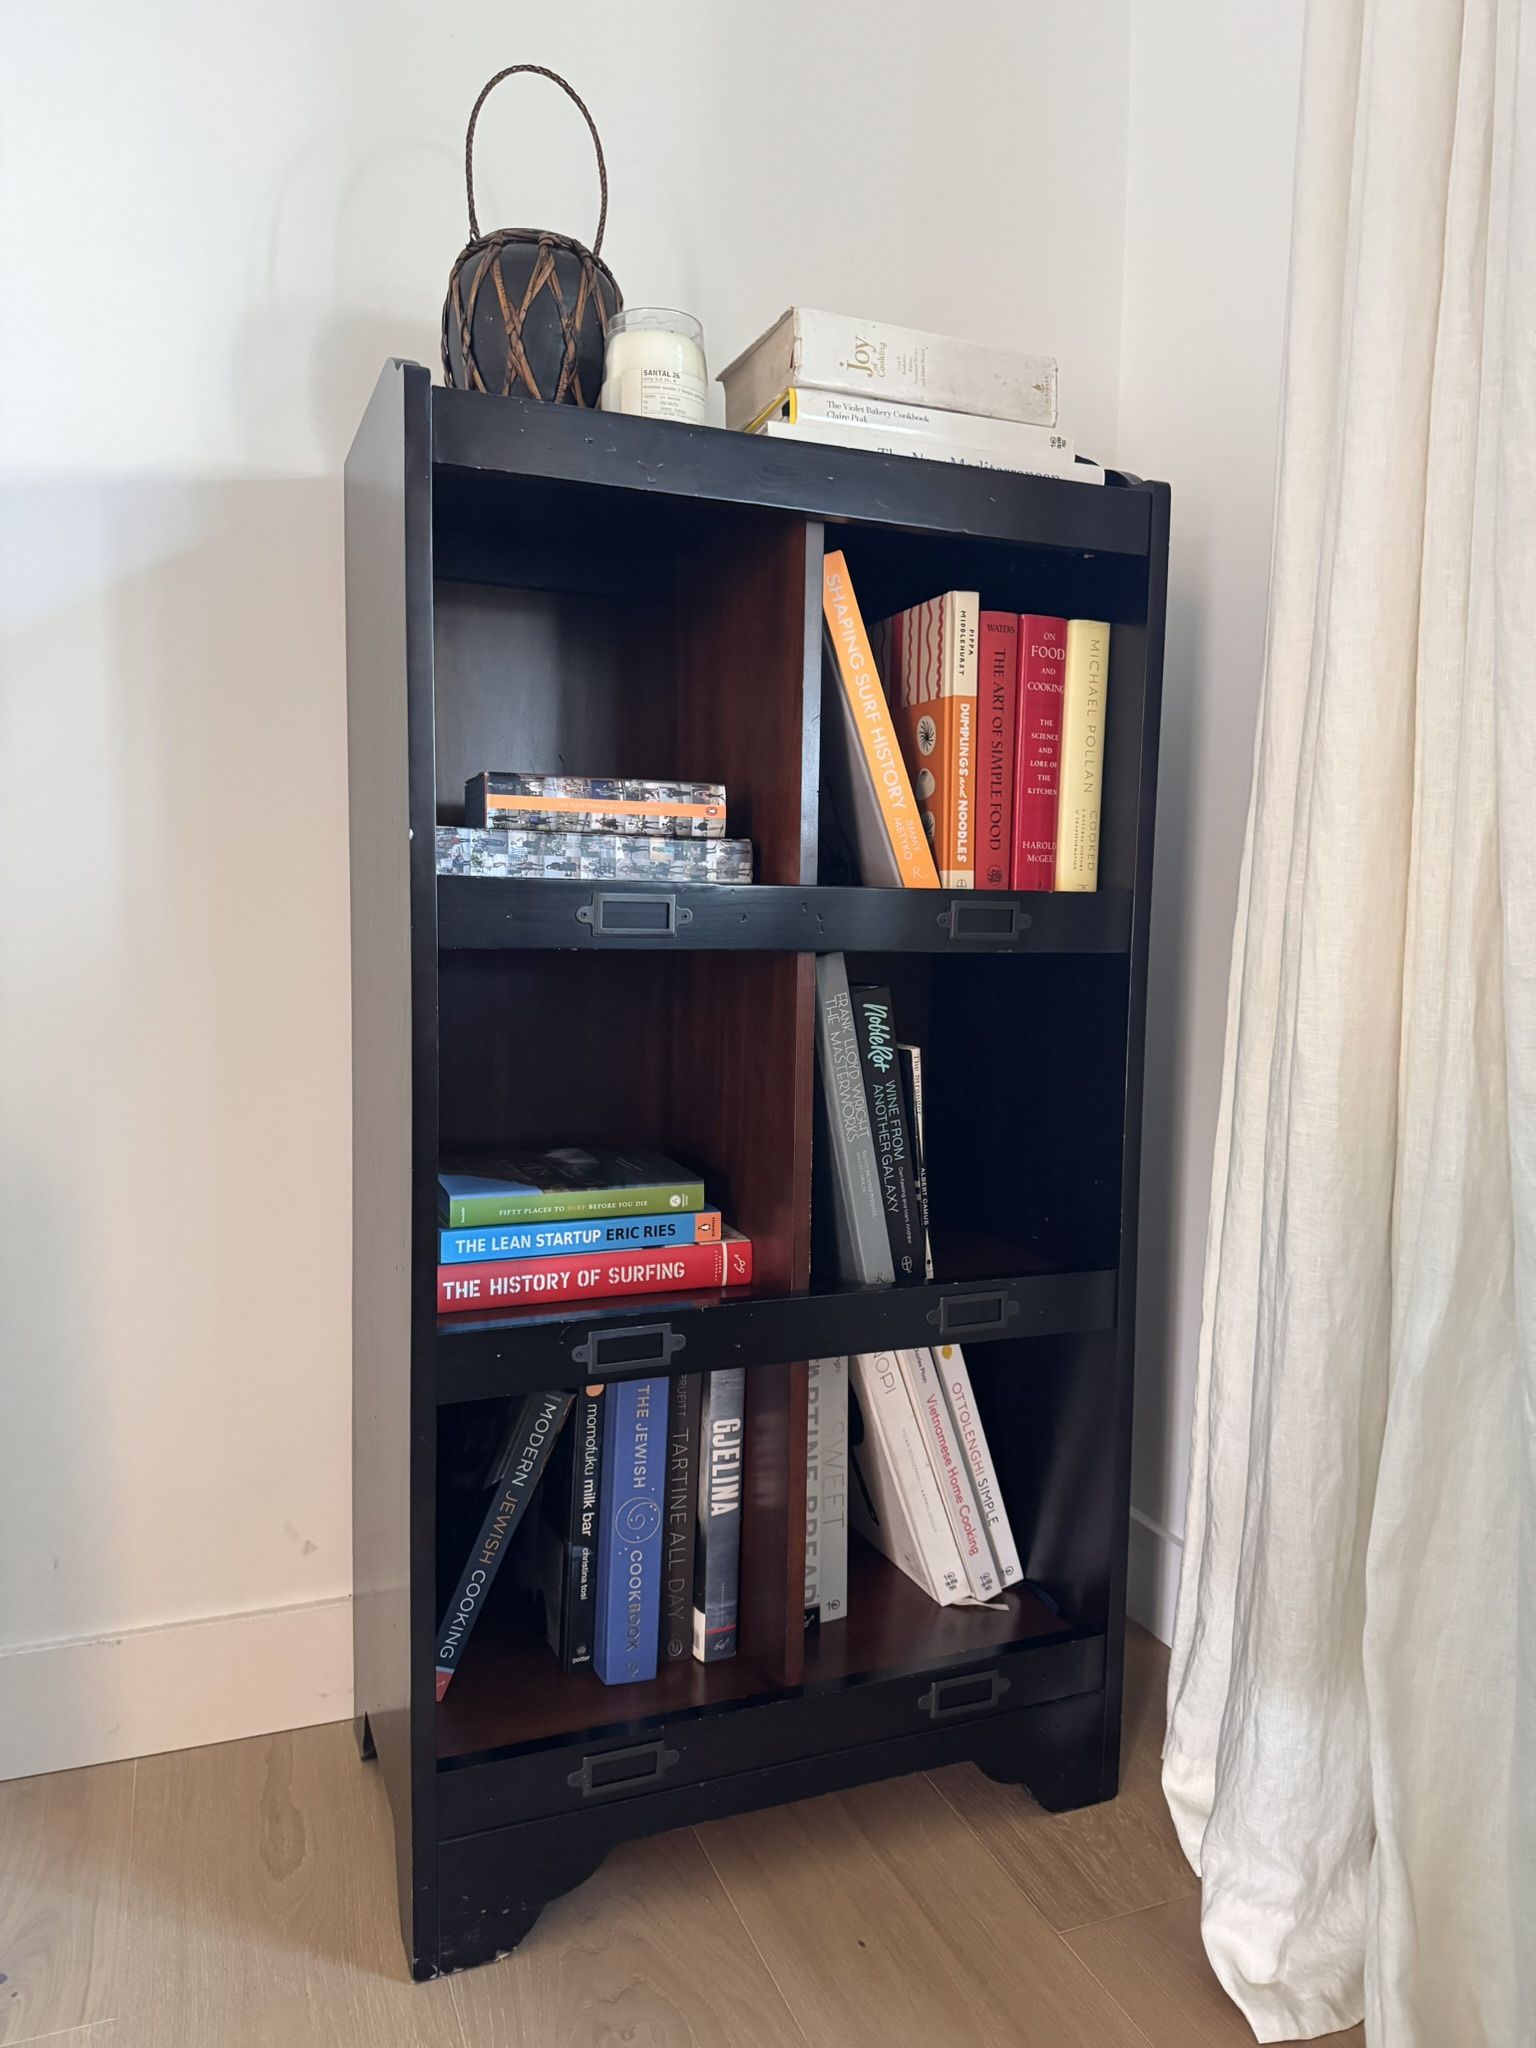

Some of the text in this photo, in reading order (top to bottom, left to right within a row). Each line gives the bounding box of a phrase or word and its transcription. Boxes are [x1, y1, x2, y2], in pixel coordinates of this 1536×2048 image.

[644, 370, 671, 378] SANTAL
[878, 341, 888, 378] Cooking
[826, 400, 930, 423] The Violet Bakery Cookbook
[826, 411, 850, 421] Claire
[958, 610, 966, 676] MIDDLEHURST
[987, 624, 1016, 634] WATERS
[1043, 632, 1056, 641] ON
[1031, 645, 1065, 661] FOOD
[826, 574, 907, 809] SHAPING SURF HISTORY
[1040, 718, 1053, 726] THE
[1083, 639, 1101, 793] MICHAEL POLLAN
[959, 703, 970, 777] DUMPLINGS
[989, 648, 1006, 851] THE ART OF SIMPLE FOOD
[1038, 746, 1053, 754] AND
[1030, 760, 1048, 768] LORE
[1038, 774, 1051, 782] THE
[1027, 788, 1058, 796] KITCHEN
[957, 800, 969, 864] NOODLES
[1022, 840, 1057, 850] HAROLD
[1086, 810, 1098, 871] COOKED
[1026, 854, 1054, 863] McGEE
[838, 992, 853, 1034] FRANK
[825, 994, 859, 1143] THE MASTERWORKS
[844, 1038, 860, 1080] LLOYD
[851, 1082, 870, 1137] WRIGHT
[885, 1080, 905, 1161] WINE FROM
[872, 1084, 900, 1213] ANOTHER GALAXY
[920, 1168, 928, 1196] ALBERT
[499, 1207, 522, 1216] FIFTY
[523, 1206, 553, 1215] PLACES
[554, 1204, 566, 1212] TO
[567, 1204, 586, 1212] SURF
[588, 1202, 616, 1210] BEFORE
[618, 1200, 636, 1209] YOU
[456, 1224, 676, 1254] THE LEAN STARTUP ERIC RIES
[442, 1278, 481, 1301] THE
[489, 1271, 569, 1297] HISTORY
[577, 1268, 600, 1288] OF
[608, 1262, 686, 1286] SURFING
[511, 1402, 558, 1487] MODERN
[952, 1382, 1000, 1528] OTTOLENGHI SIMPLE
[582, 1404, 598, 1536] momofuku milk bar
[670, 1428, 690, 1524] TARTINE
[711, 1418, 742, 1517] GJELINA
[822, 1420, 845, 1528] SWEET
[926, 1393, 979, 1557] Vietnamese Home Cooking
[479, 1490, 518, 1565] JEWISH
[627, 1384, 650, 1652] THE JEWISH COOKBOOK
[580, 1547, 590, 1600] christina tosi
[668, 1532, 687, 1573] ALL
[440, 1570, 486, 1658] COOKING
[667, 1578, 685, 1620] DAY
[572, 1655, 591, 1665] potter
